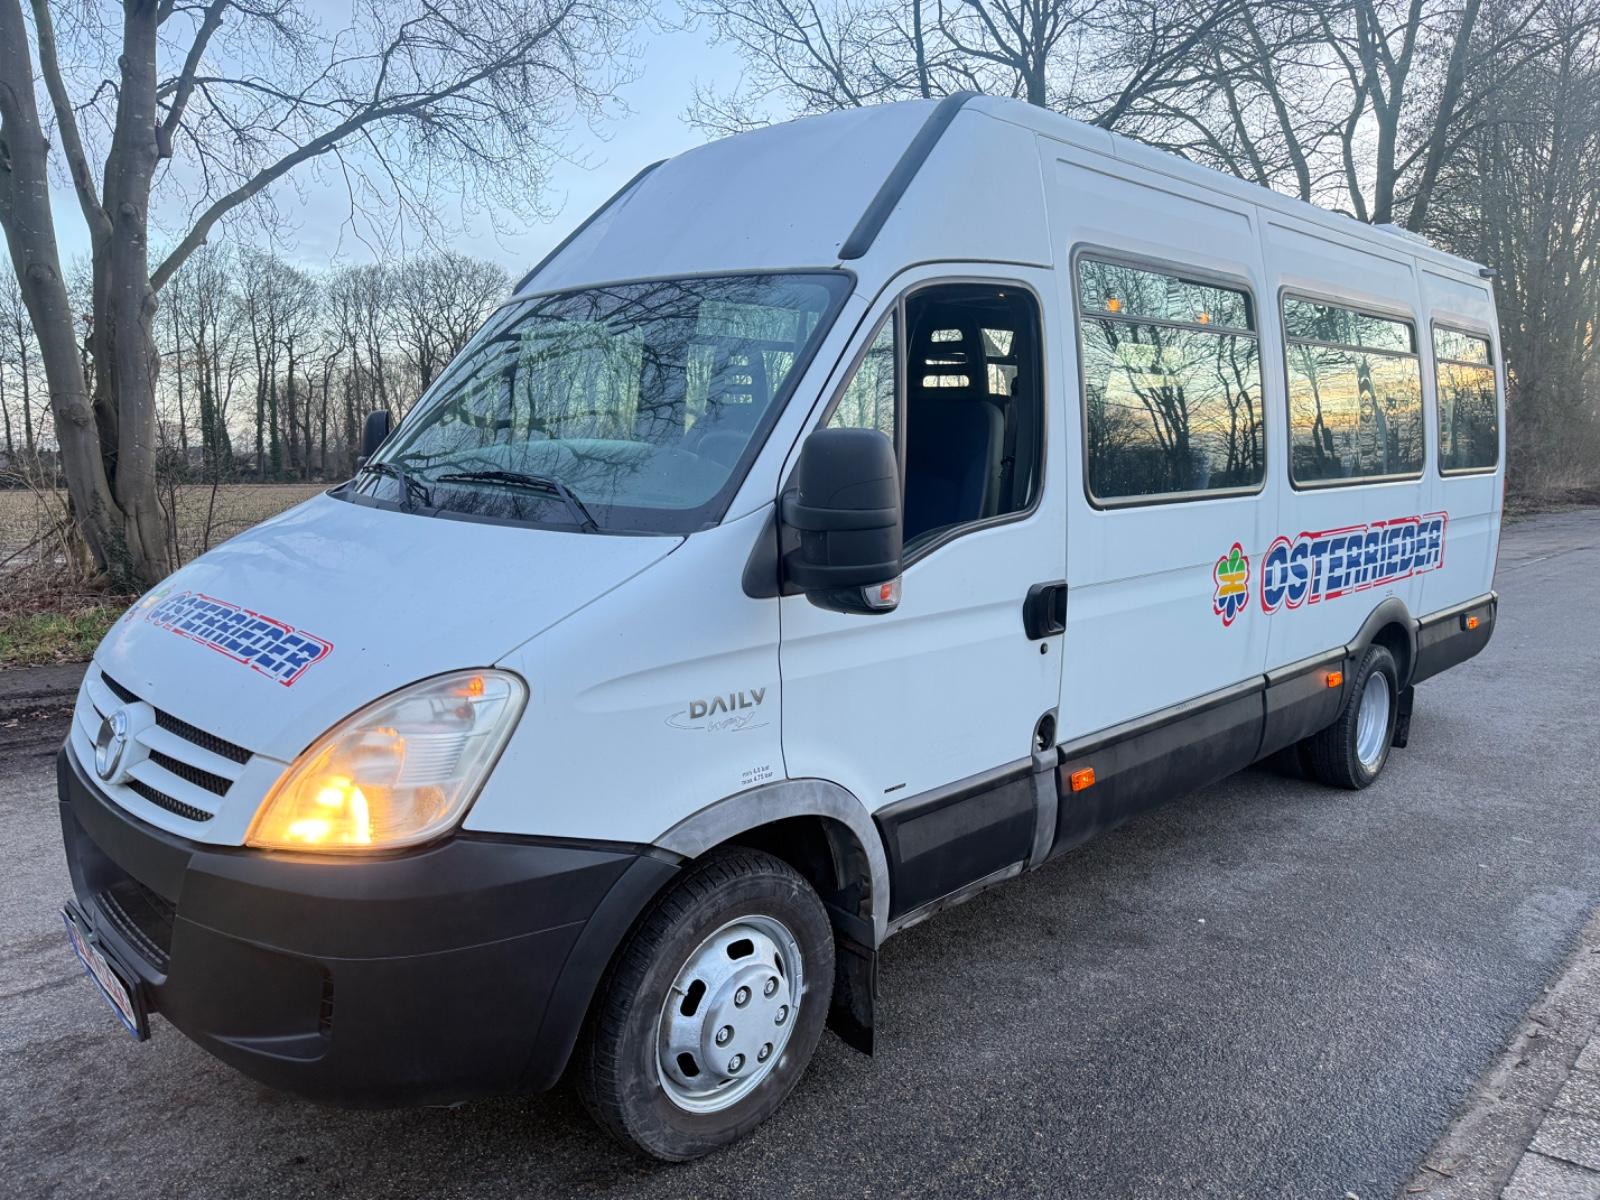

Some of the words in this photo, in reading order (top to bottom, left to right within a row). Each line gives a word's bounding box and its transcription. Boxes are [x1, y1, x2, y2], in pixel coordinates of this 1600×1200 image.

[1262, 515, 1446, 612] OSTERRIEDER
[147, 592, 331, 684] OSTERRIEDER
[689, 687, 766, 719] DAILY
